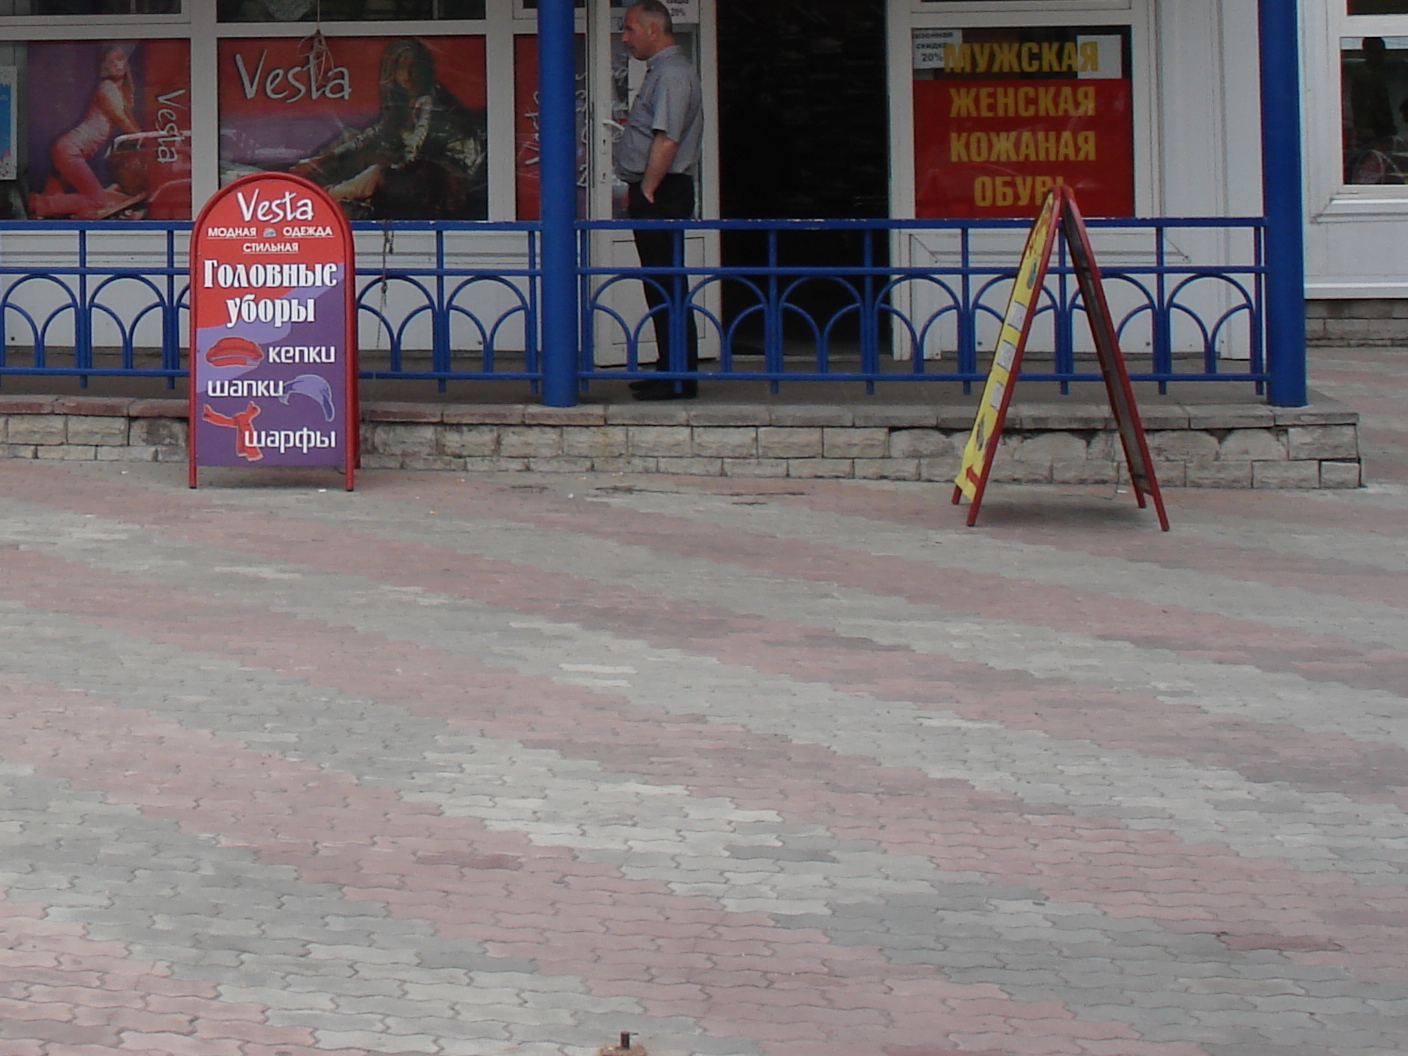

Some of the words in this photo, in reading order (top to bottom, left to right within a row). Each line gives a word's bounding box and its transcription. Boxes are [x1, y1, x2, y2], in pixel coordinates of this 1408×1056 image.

[943, 41, 1099, 73] МУЖСКАЯ
[234, 49, 353, 103] Vesta
[949, 86, 1096, 118] ЖЕНСКАЯ
[156, 89, 189, 164] Vesta
[950, 131, 1097, 162] КОЖАНАЯ
[236, 188, 314, 224] Vesta
[973, 176, 1066, 208] ОБУВ
[207, 227, 257, 238] МОДНАЯ
[282, 226, 334, 238] ОДЕЖДА
[243, 242, 299, 253] СТИЛЬНАЯ
[203, 260, 338, 288] Головные
[226, 296, 315, 328] уборы
[268, 345, 335, 364] кепки
[207, 379, 284, 397] шапки
[244, 427, 336, 454] шарфы
